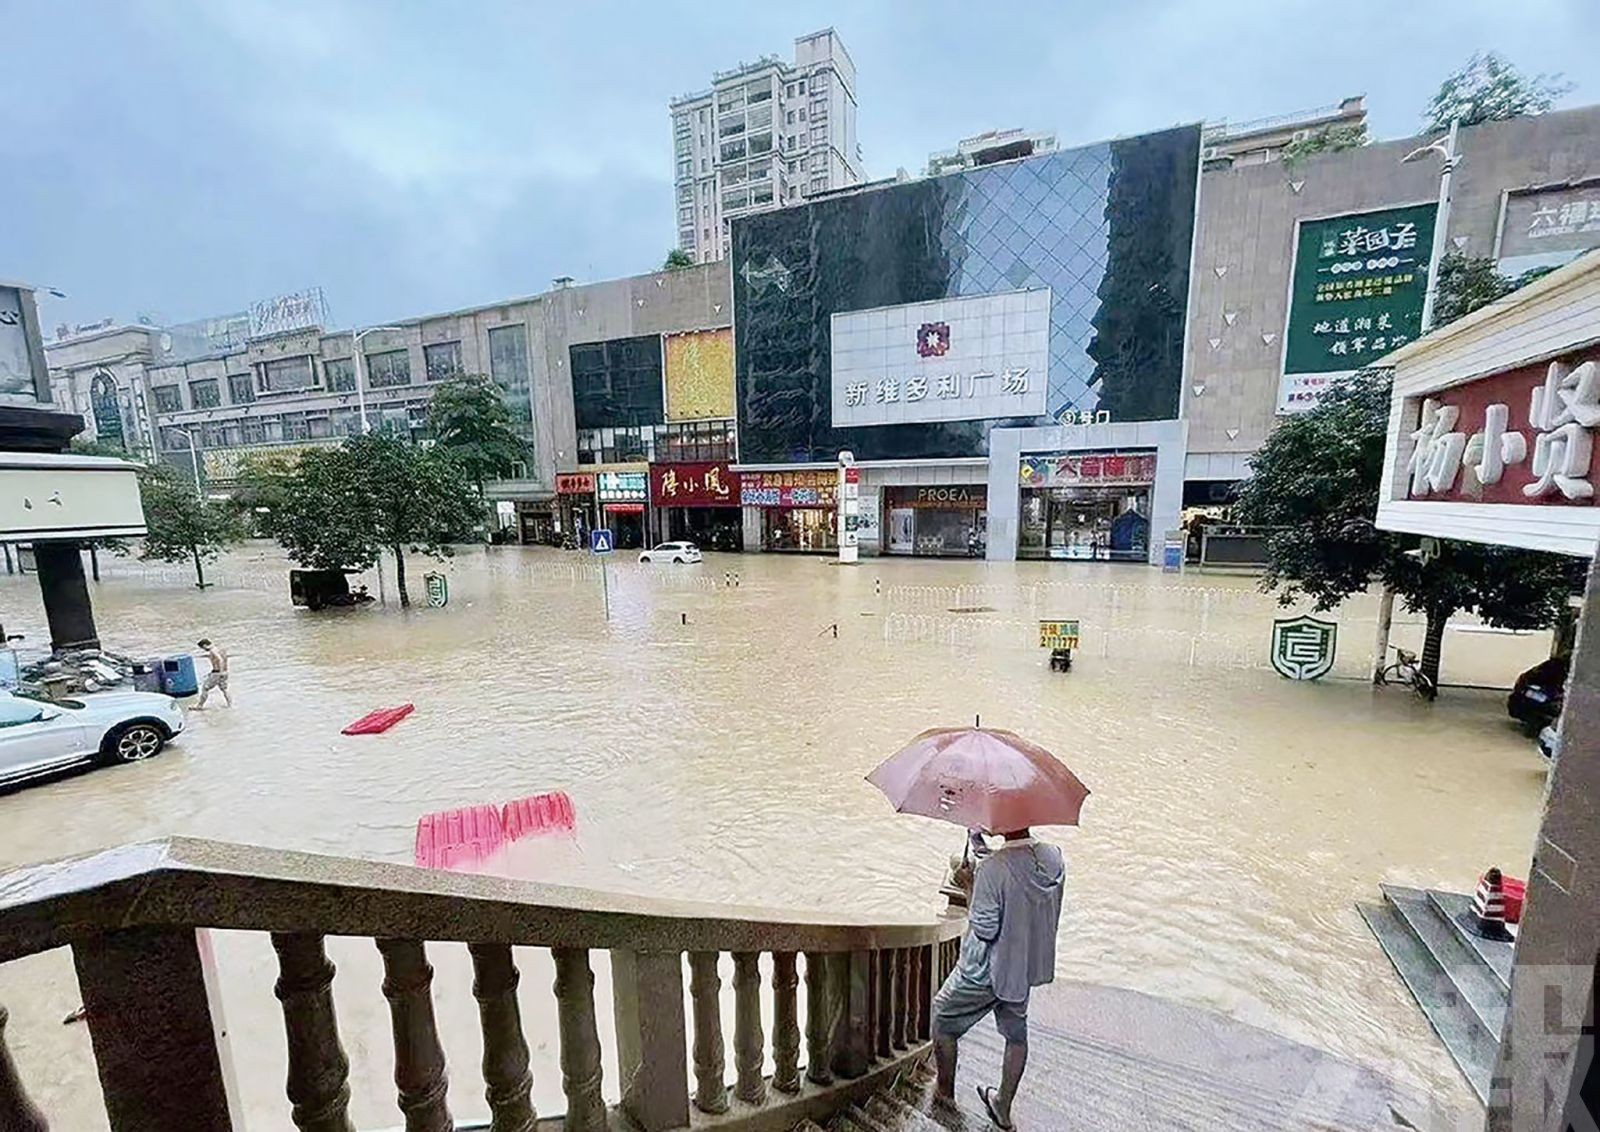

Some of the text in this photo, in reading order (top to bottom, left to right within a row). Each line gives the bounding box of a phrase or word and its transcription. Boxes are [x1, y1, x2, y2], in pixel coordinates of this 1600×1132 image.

[1313, 312, 1392, 334] 地道湘菜
[846, 367, 1029, 406] 新维多利广场
